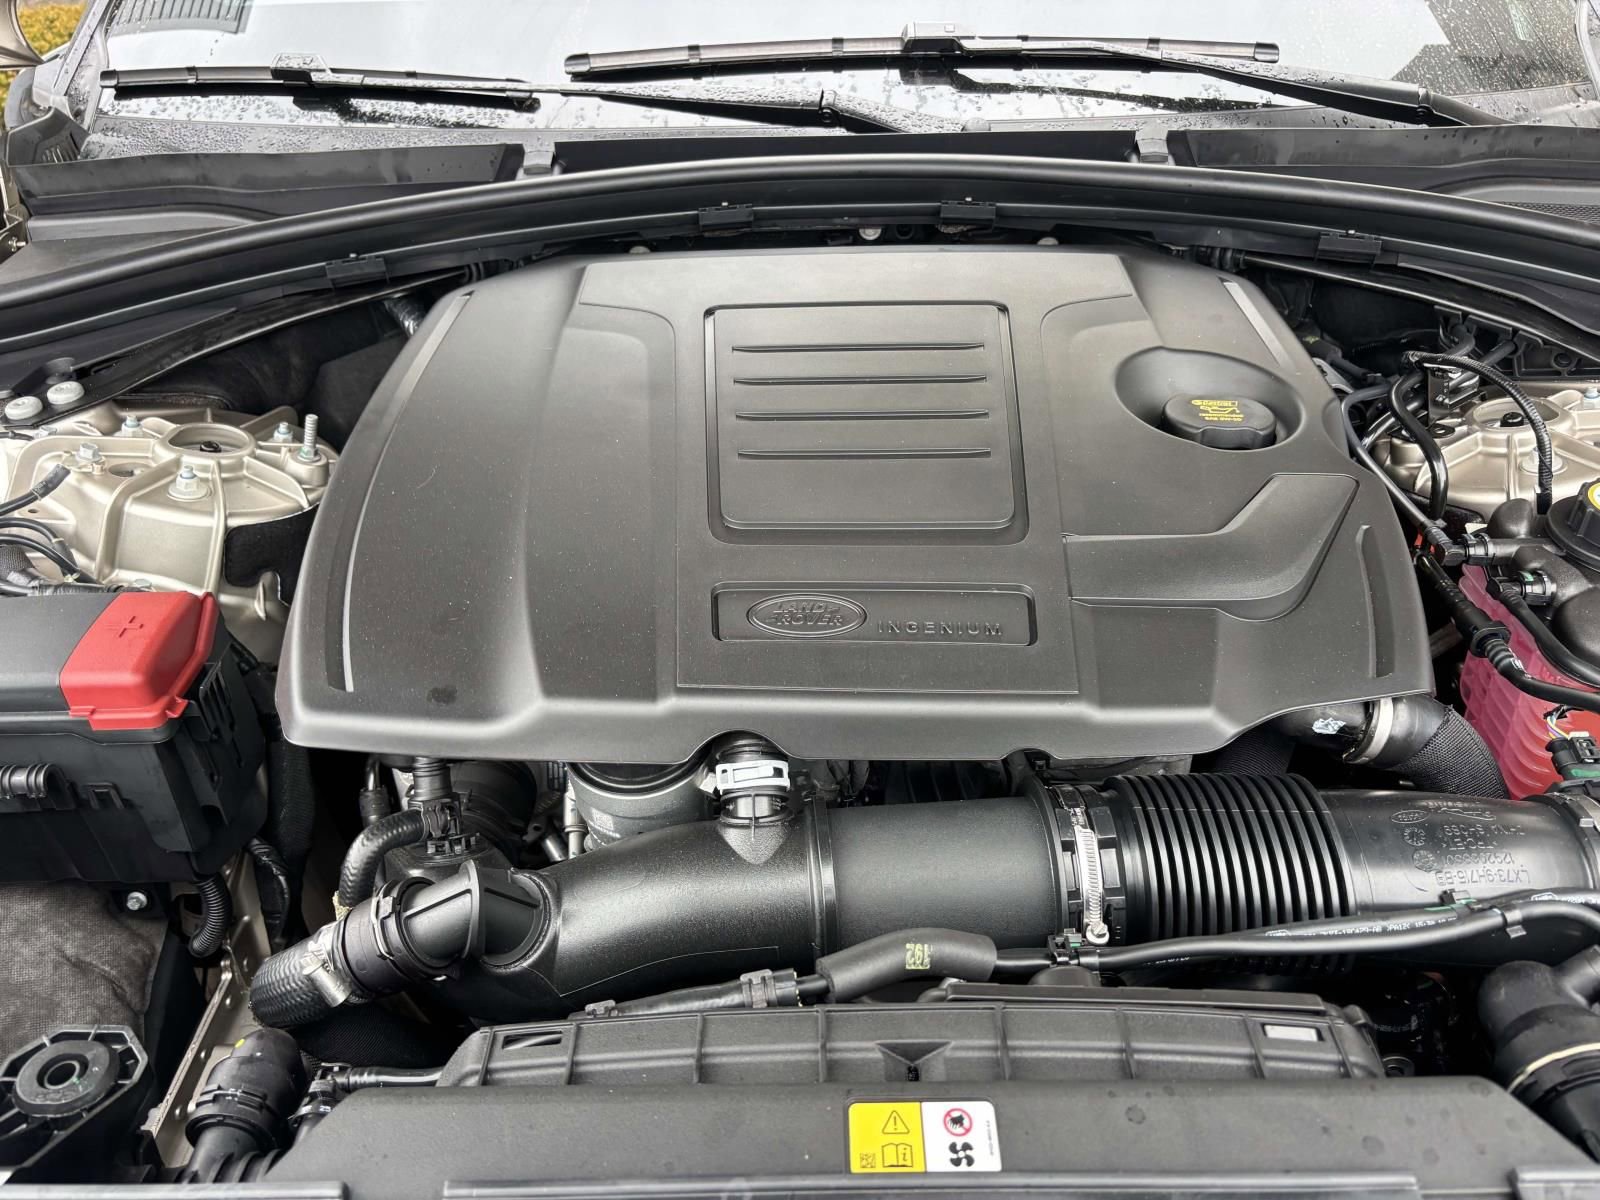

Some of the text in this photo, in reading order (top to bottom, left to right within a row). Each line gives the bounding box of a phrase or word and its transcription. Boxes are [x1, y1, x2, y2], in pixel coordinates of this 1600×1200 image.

[773, 602, 828, 613] LAND
[777, 614, 843, 626] ROVER
[877, 620, 1002, 636] INGENIUM
